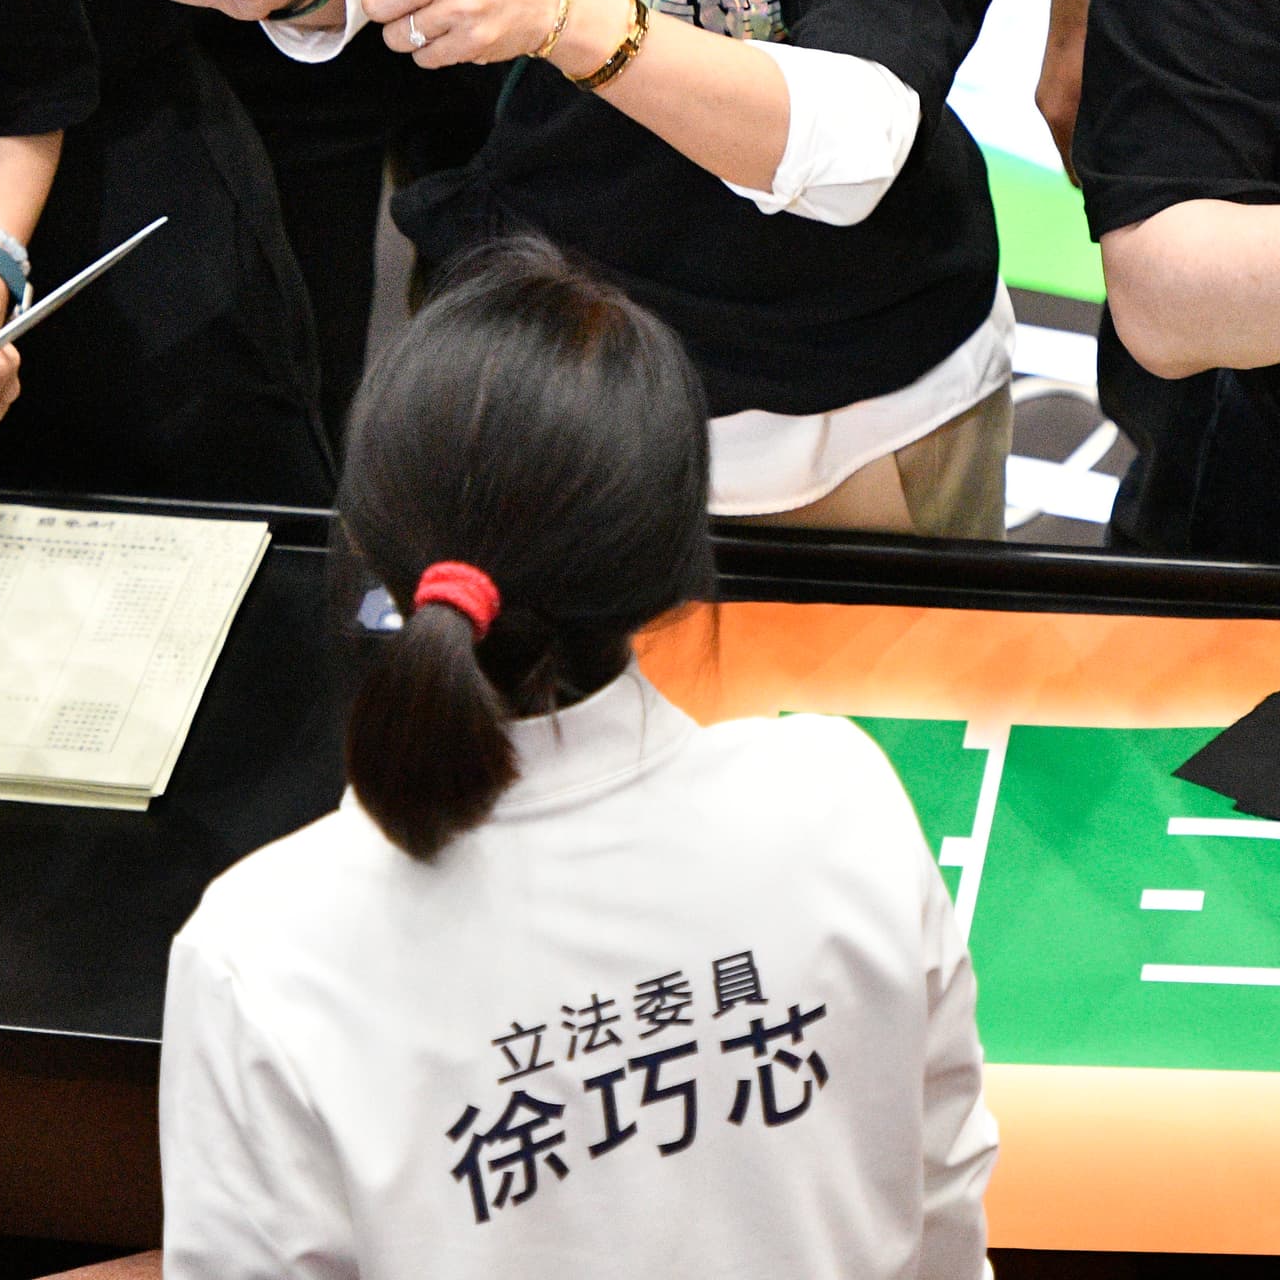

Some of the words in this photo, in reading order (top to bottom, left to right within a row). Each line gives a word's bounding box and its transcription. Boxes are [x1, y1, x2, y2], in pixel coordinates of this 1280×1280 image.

[491, 950, 769, 1086] 立法委員
[444, 1002, 829, 1225] 徐巧芯
